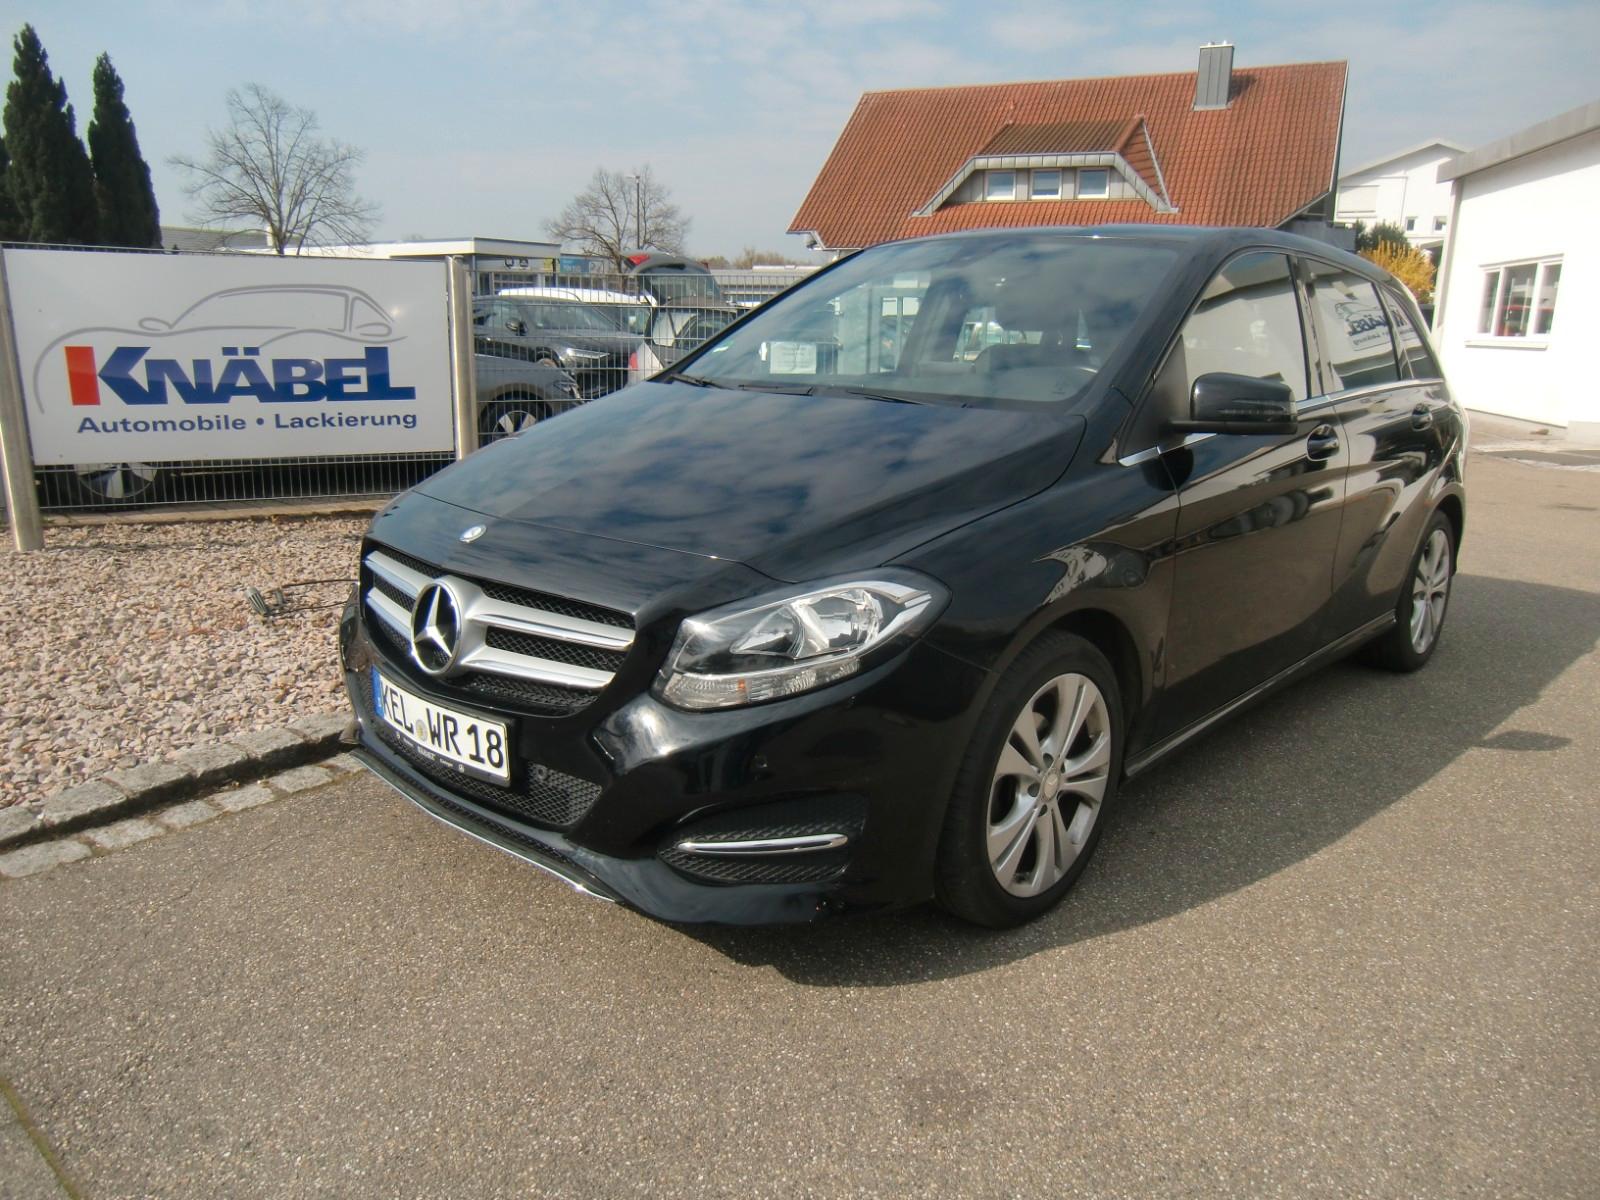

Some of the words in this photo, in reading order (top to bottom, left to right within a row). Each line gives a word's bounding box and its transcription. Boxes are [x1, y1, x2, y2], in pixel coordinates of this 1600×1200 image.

[64, 346, 416, 405] KNÄBEL
[77, 415, 247, 433] Automobile
[274, 411, 417, 429] Lackierung
[381, 681, 414, 734] KEL
